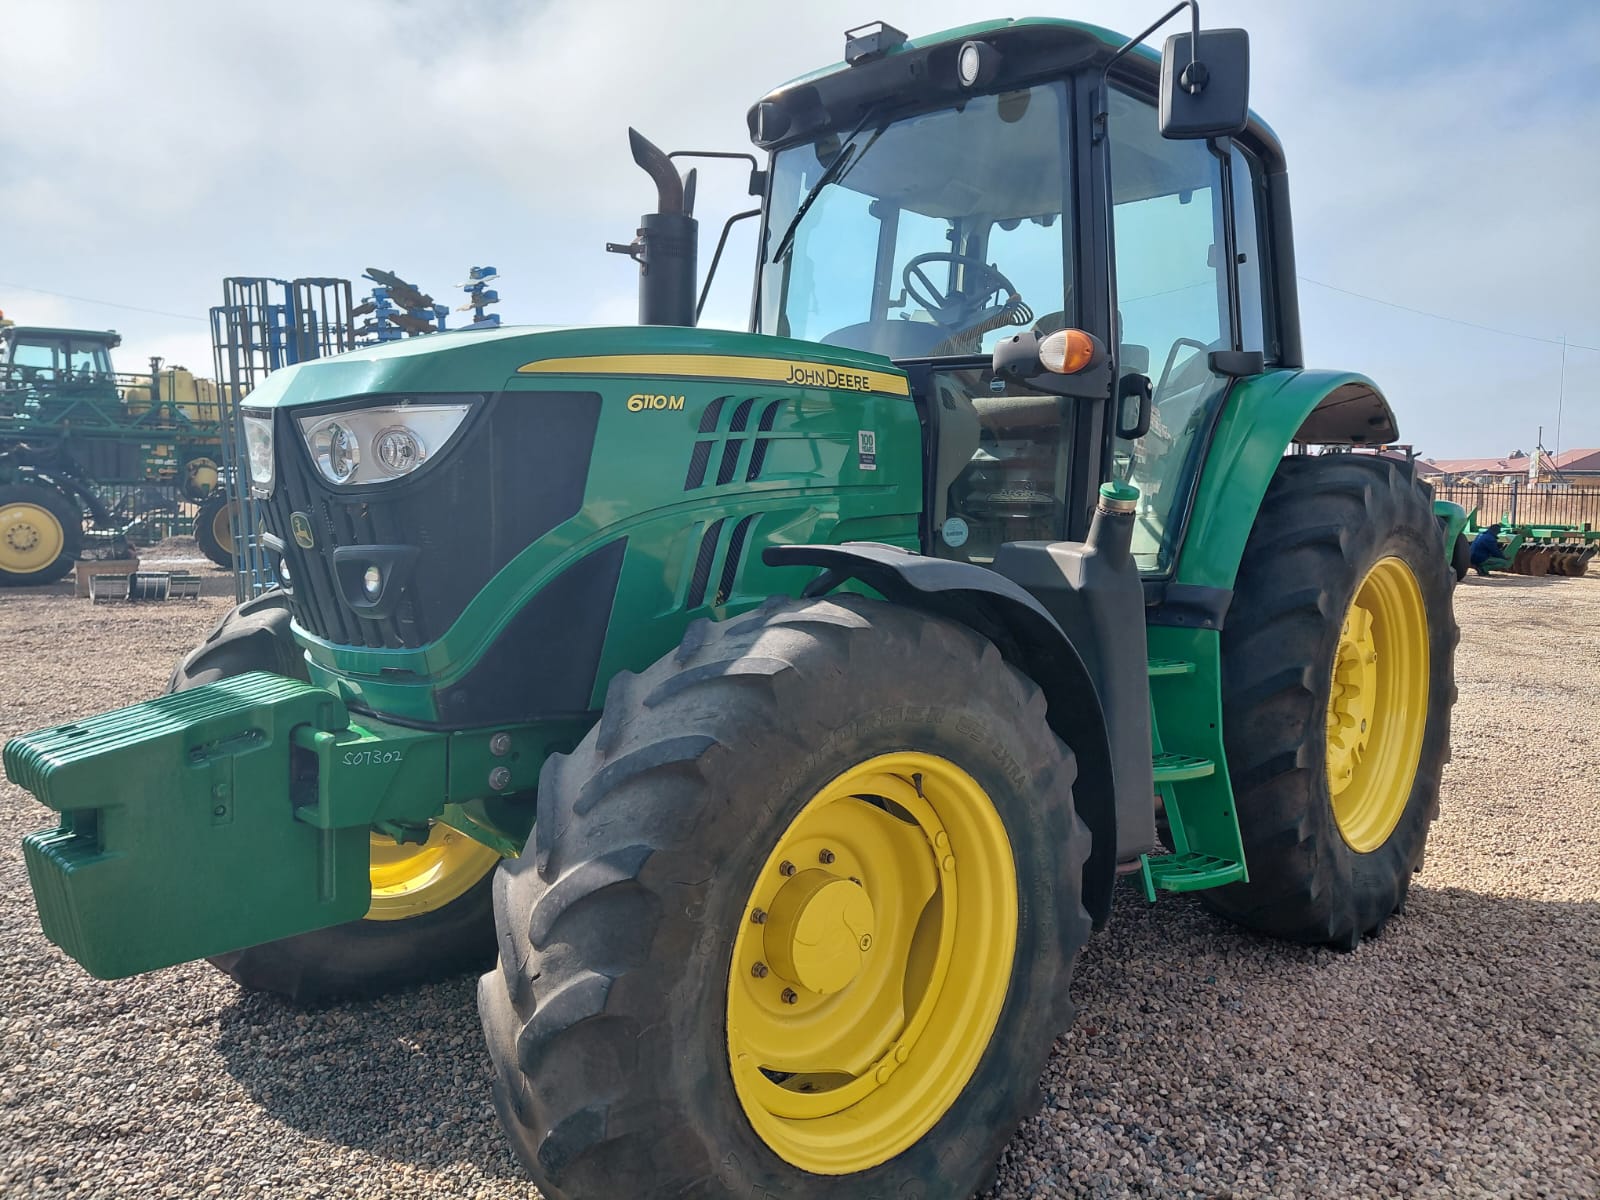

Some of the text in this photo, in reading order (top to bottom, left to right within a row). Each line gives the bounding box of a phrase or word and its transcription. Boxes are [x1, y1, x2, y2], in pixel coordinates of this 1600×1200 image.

[786, 365, 871, 390] JOHN DEERE
[860, 433, 874, 446] 100
